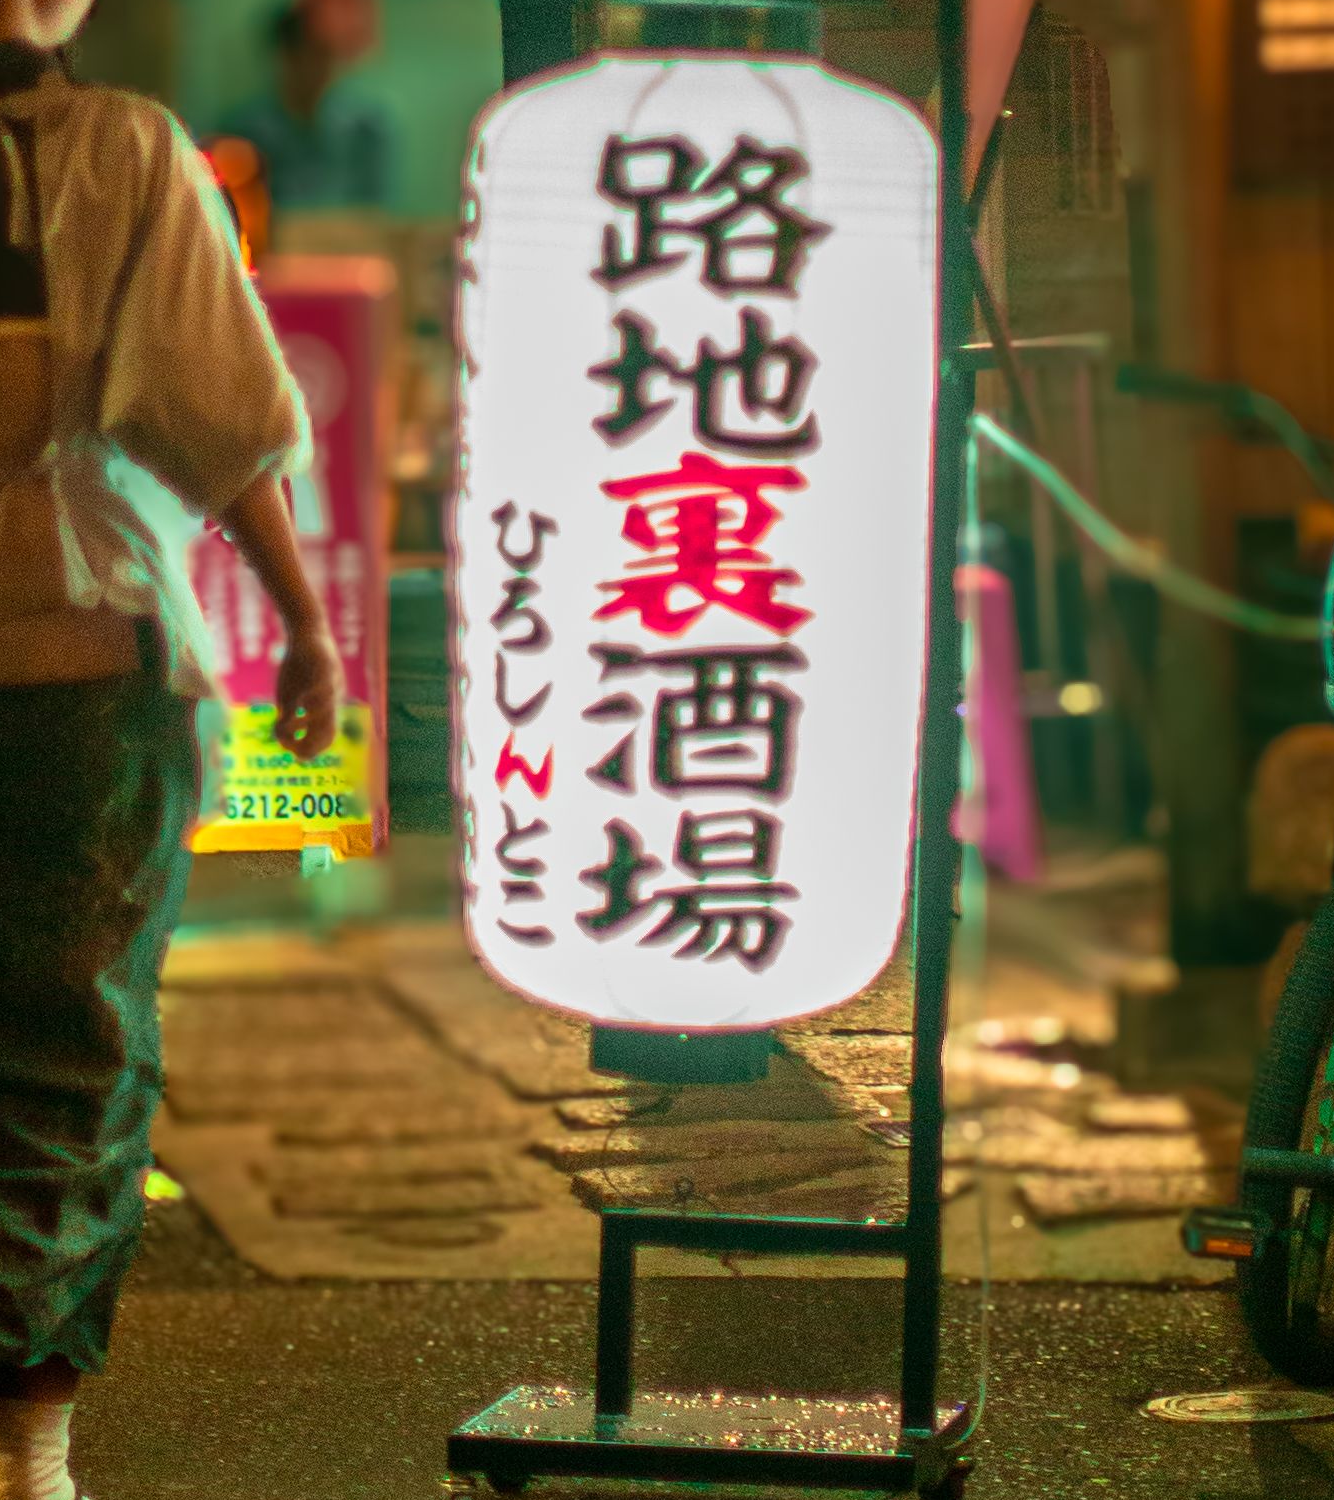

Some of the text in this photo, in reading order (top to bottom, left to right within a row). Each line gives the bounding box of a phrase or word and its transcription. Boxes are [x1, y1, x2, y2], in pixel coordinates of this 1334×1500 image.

[576, 131, 833, 976] 路地裏酒場
